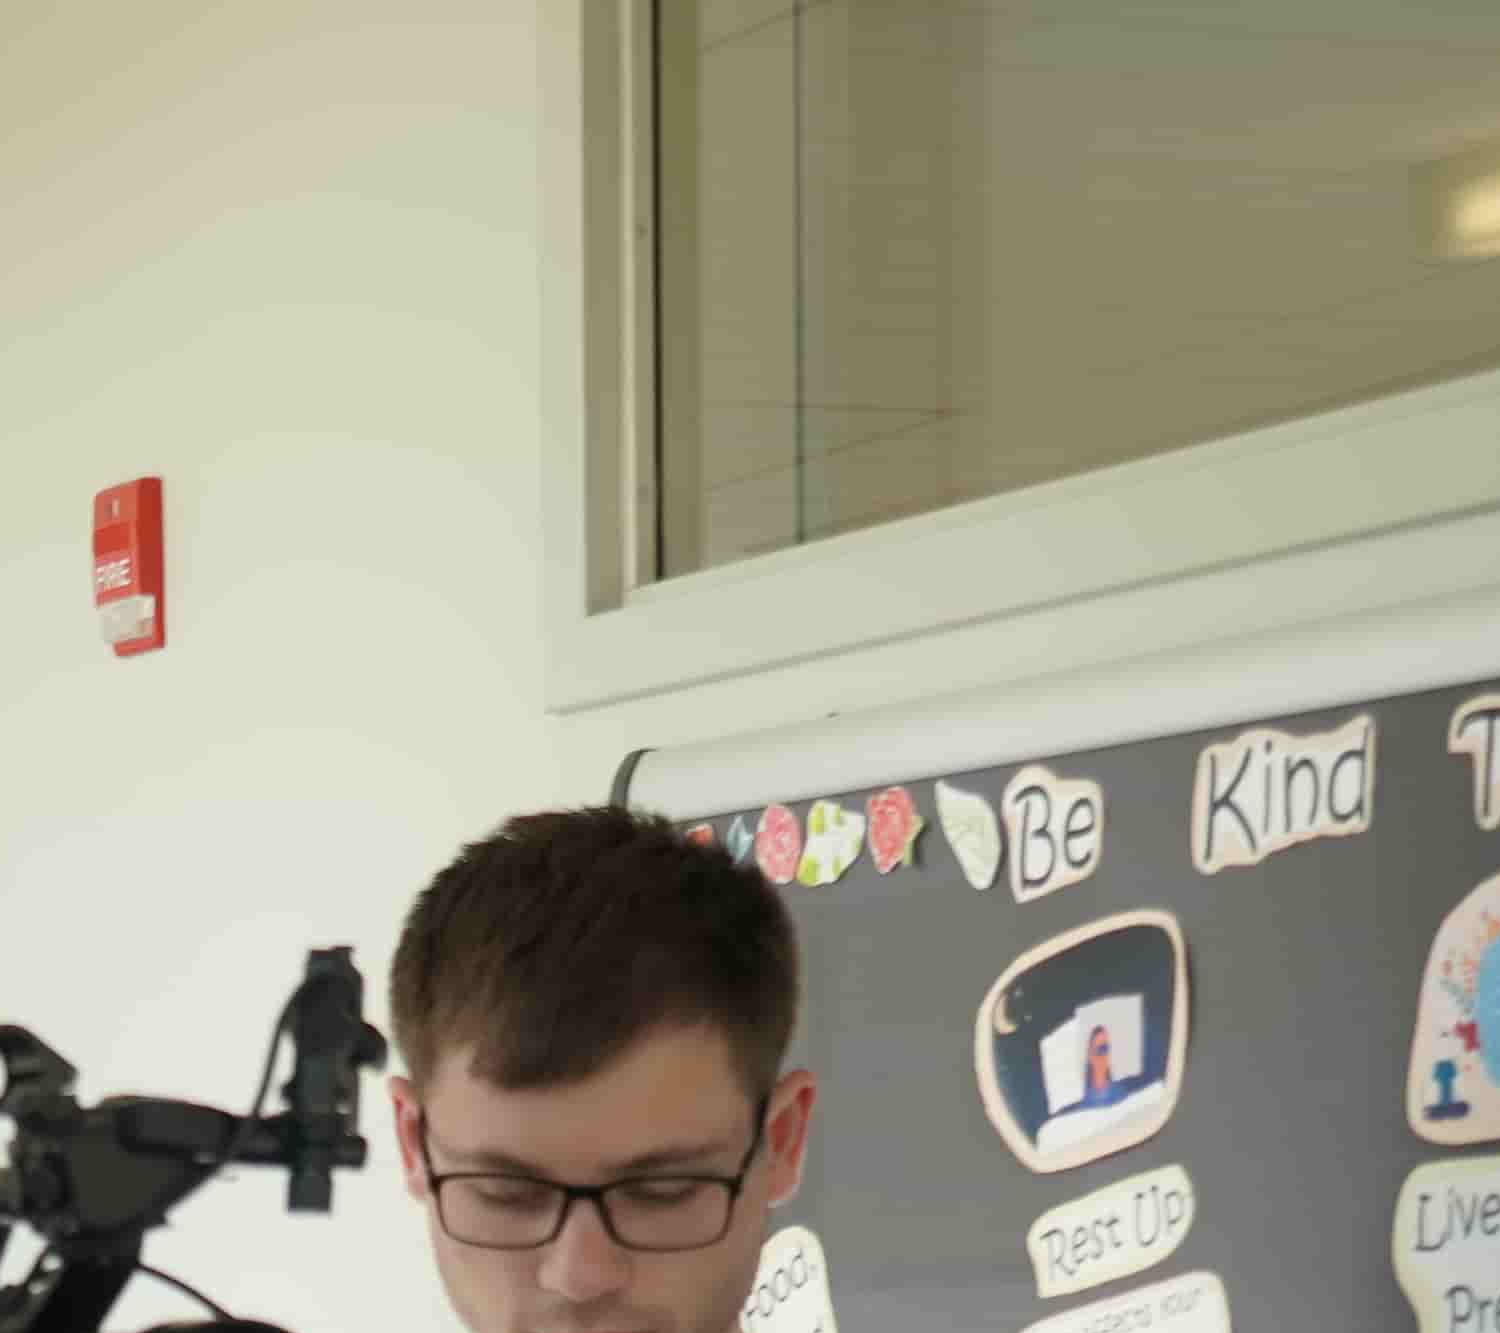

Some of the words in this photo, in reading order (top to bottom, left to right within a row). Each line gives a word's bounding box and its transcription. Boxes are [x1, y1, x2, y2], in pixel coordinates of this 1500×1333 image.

[95, 556, 133, 593] FIRE
[1012, 784, 1095, 887] Be
[1203, 734, 1369, 857] Kind
[1039, 1216, 1123, 1282] Rest
[1133, 1184, 1186, 1247] Up
